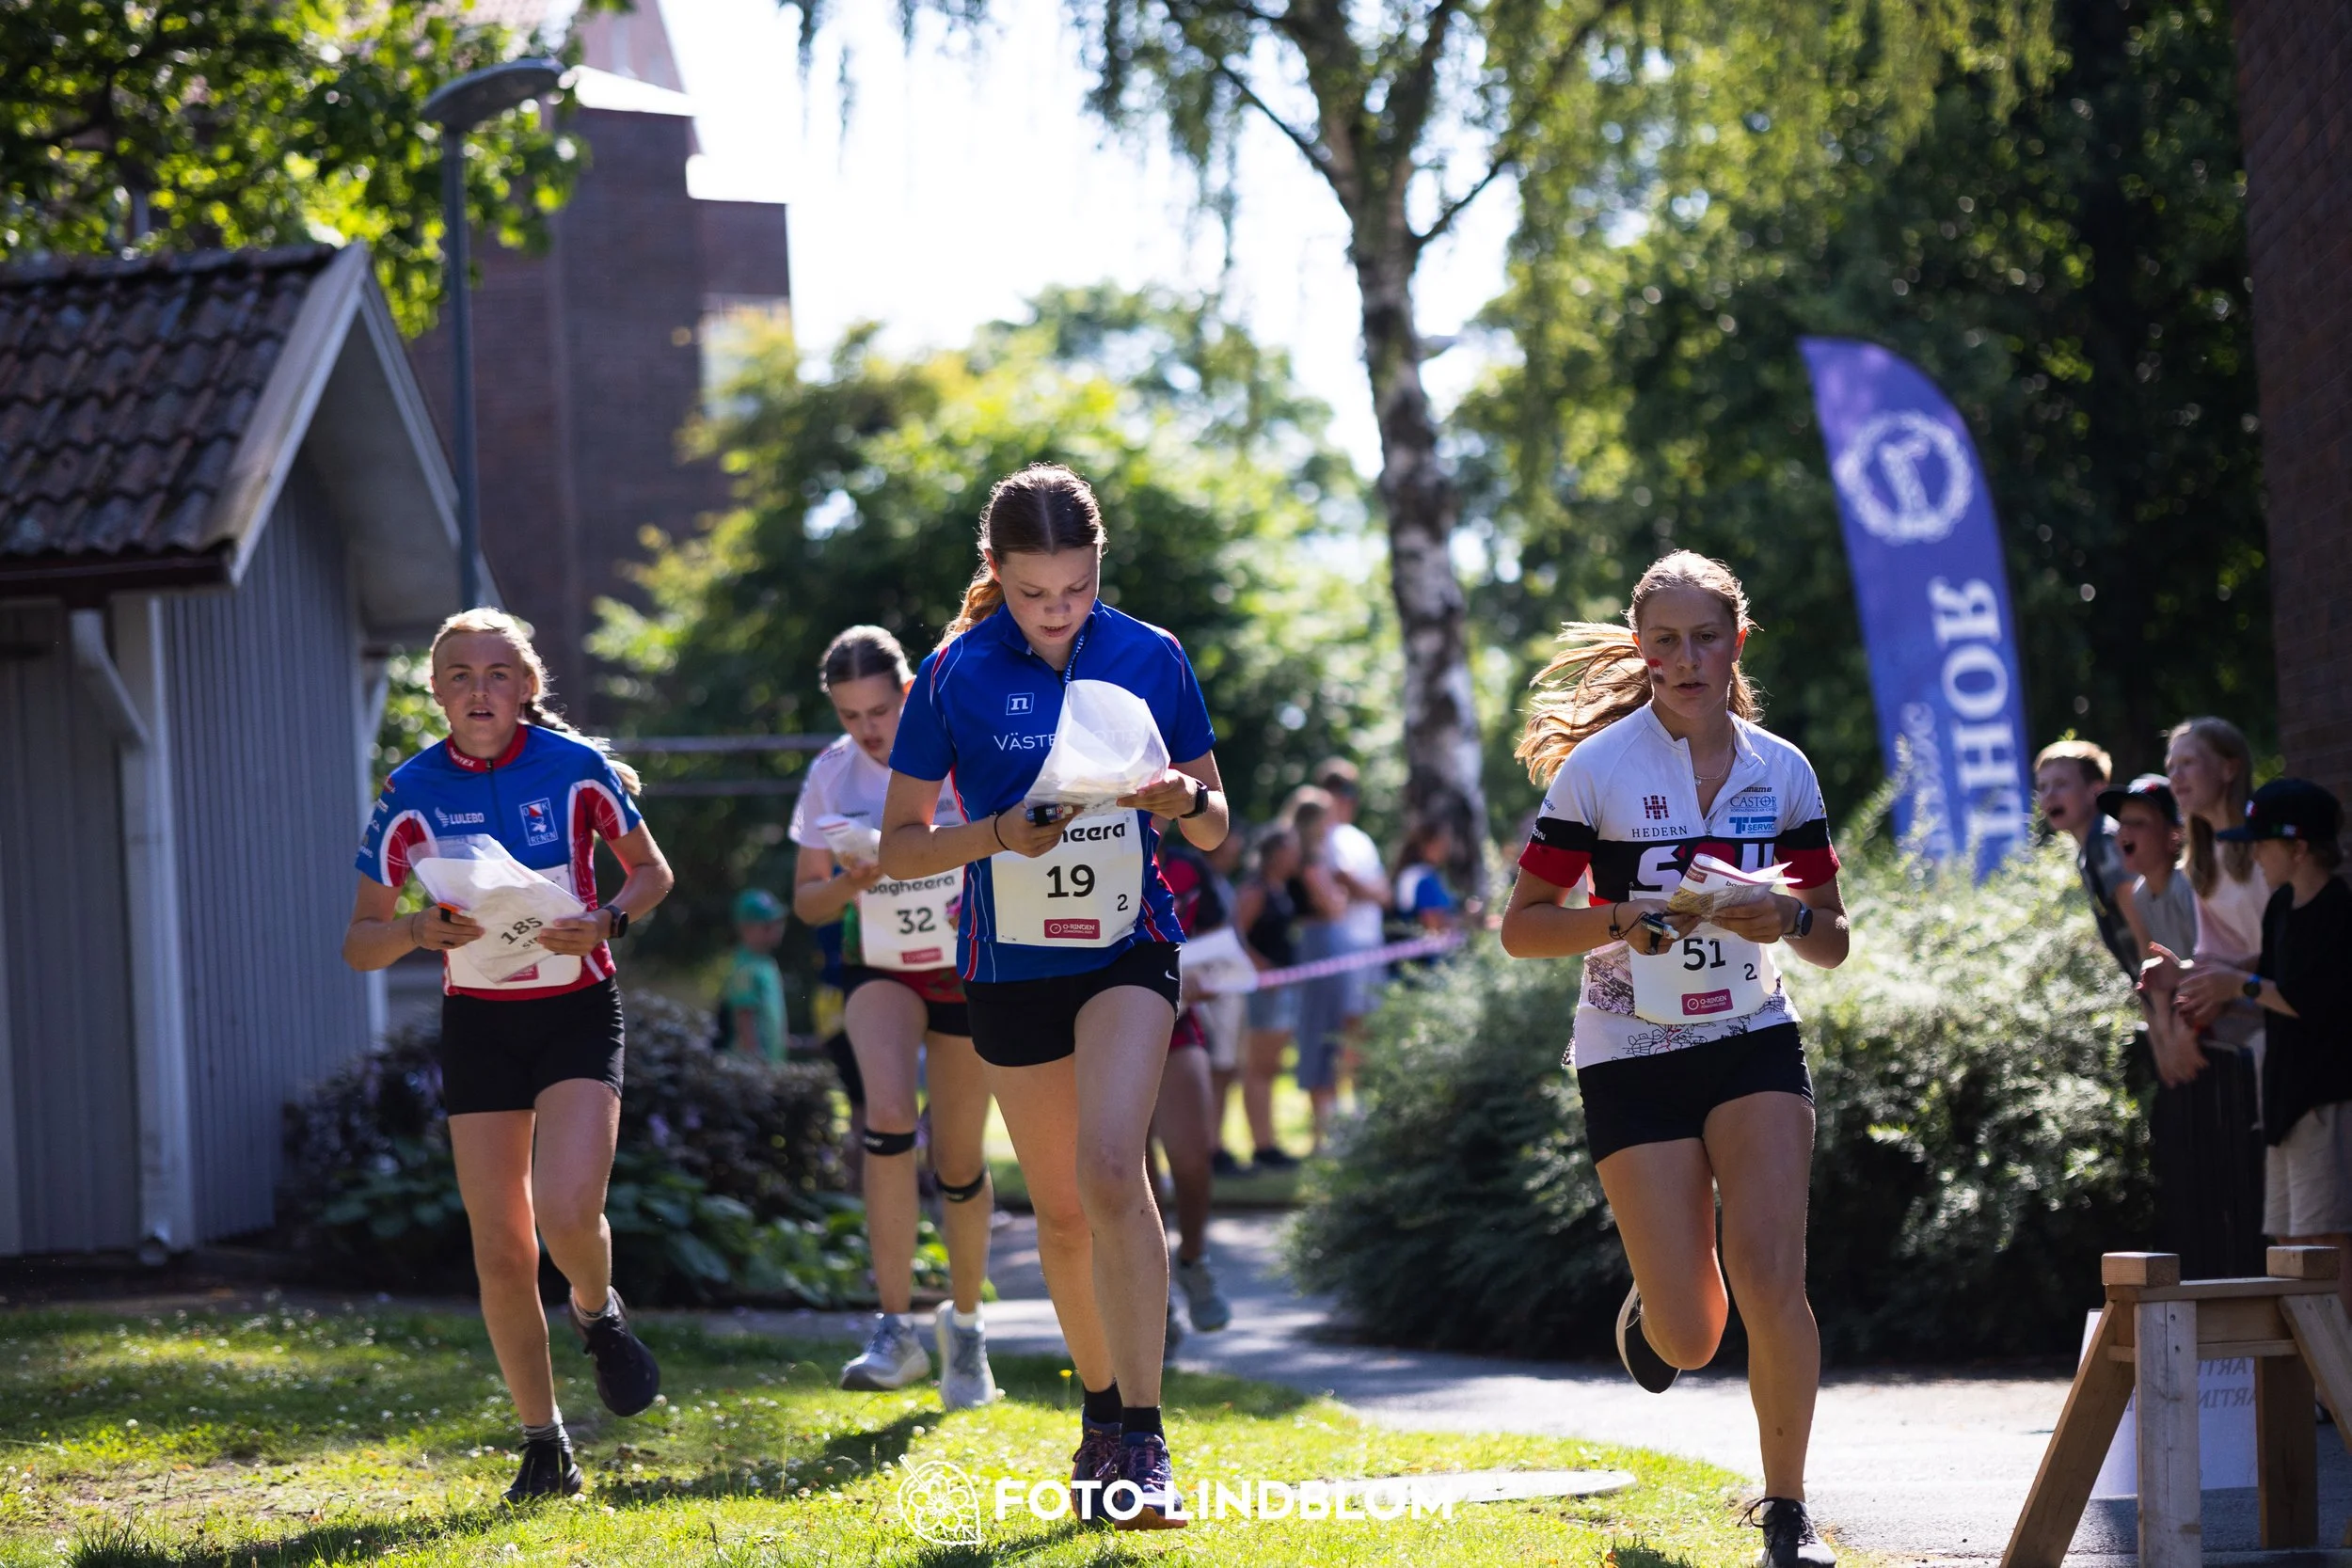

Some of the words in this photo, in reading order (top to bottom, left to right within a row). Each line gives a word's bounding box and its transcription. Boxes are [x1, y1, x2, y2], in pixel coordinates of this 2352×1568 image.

[450, 813, 485, 825] LULEBO
[1747, 823, 1775, 832] SERVIC
[530, 832, 557, 844] RENEN
[1062, 822, 1126, 843] eera
[1632, 825, 1688, 839] HEDERN
[1046, 864, 1095, 898] 19
[1117, 894, 1129, 911] 2
[897, 907, 936, 935] 32
[501, 917, 544, 945] 185
[1682, 937, 1726, 971] 51
[1743, 962, 1758, 981] 2
